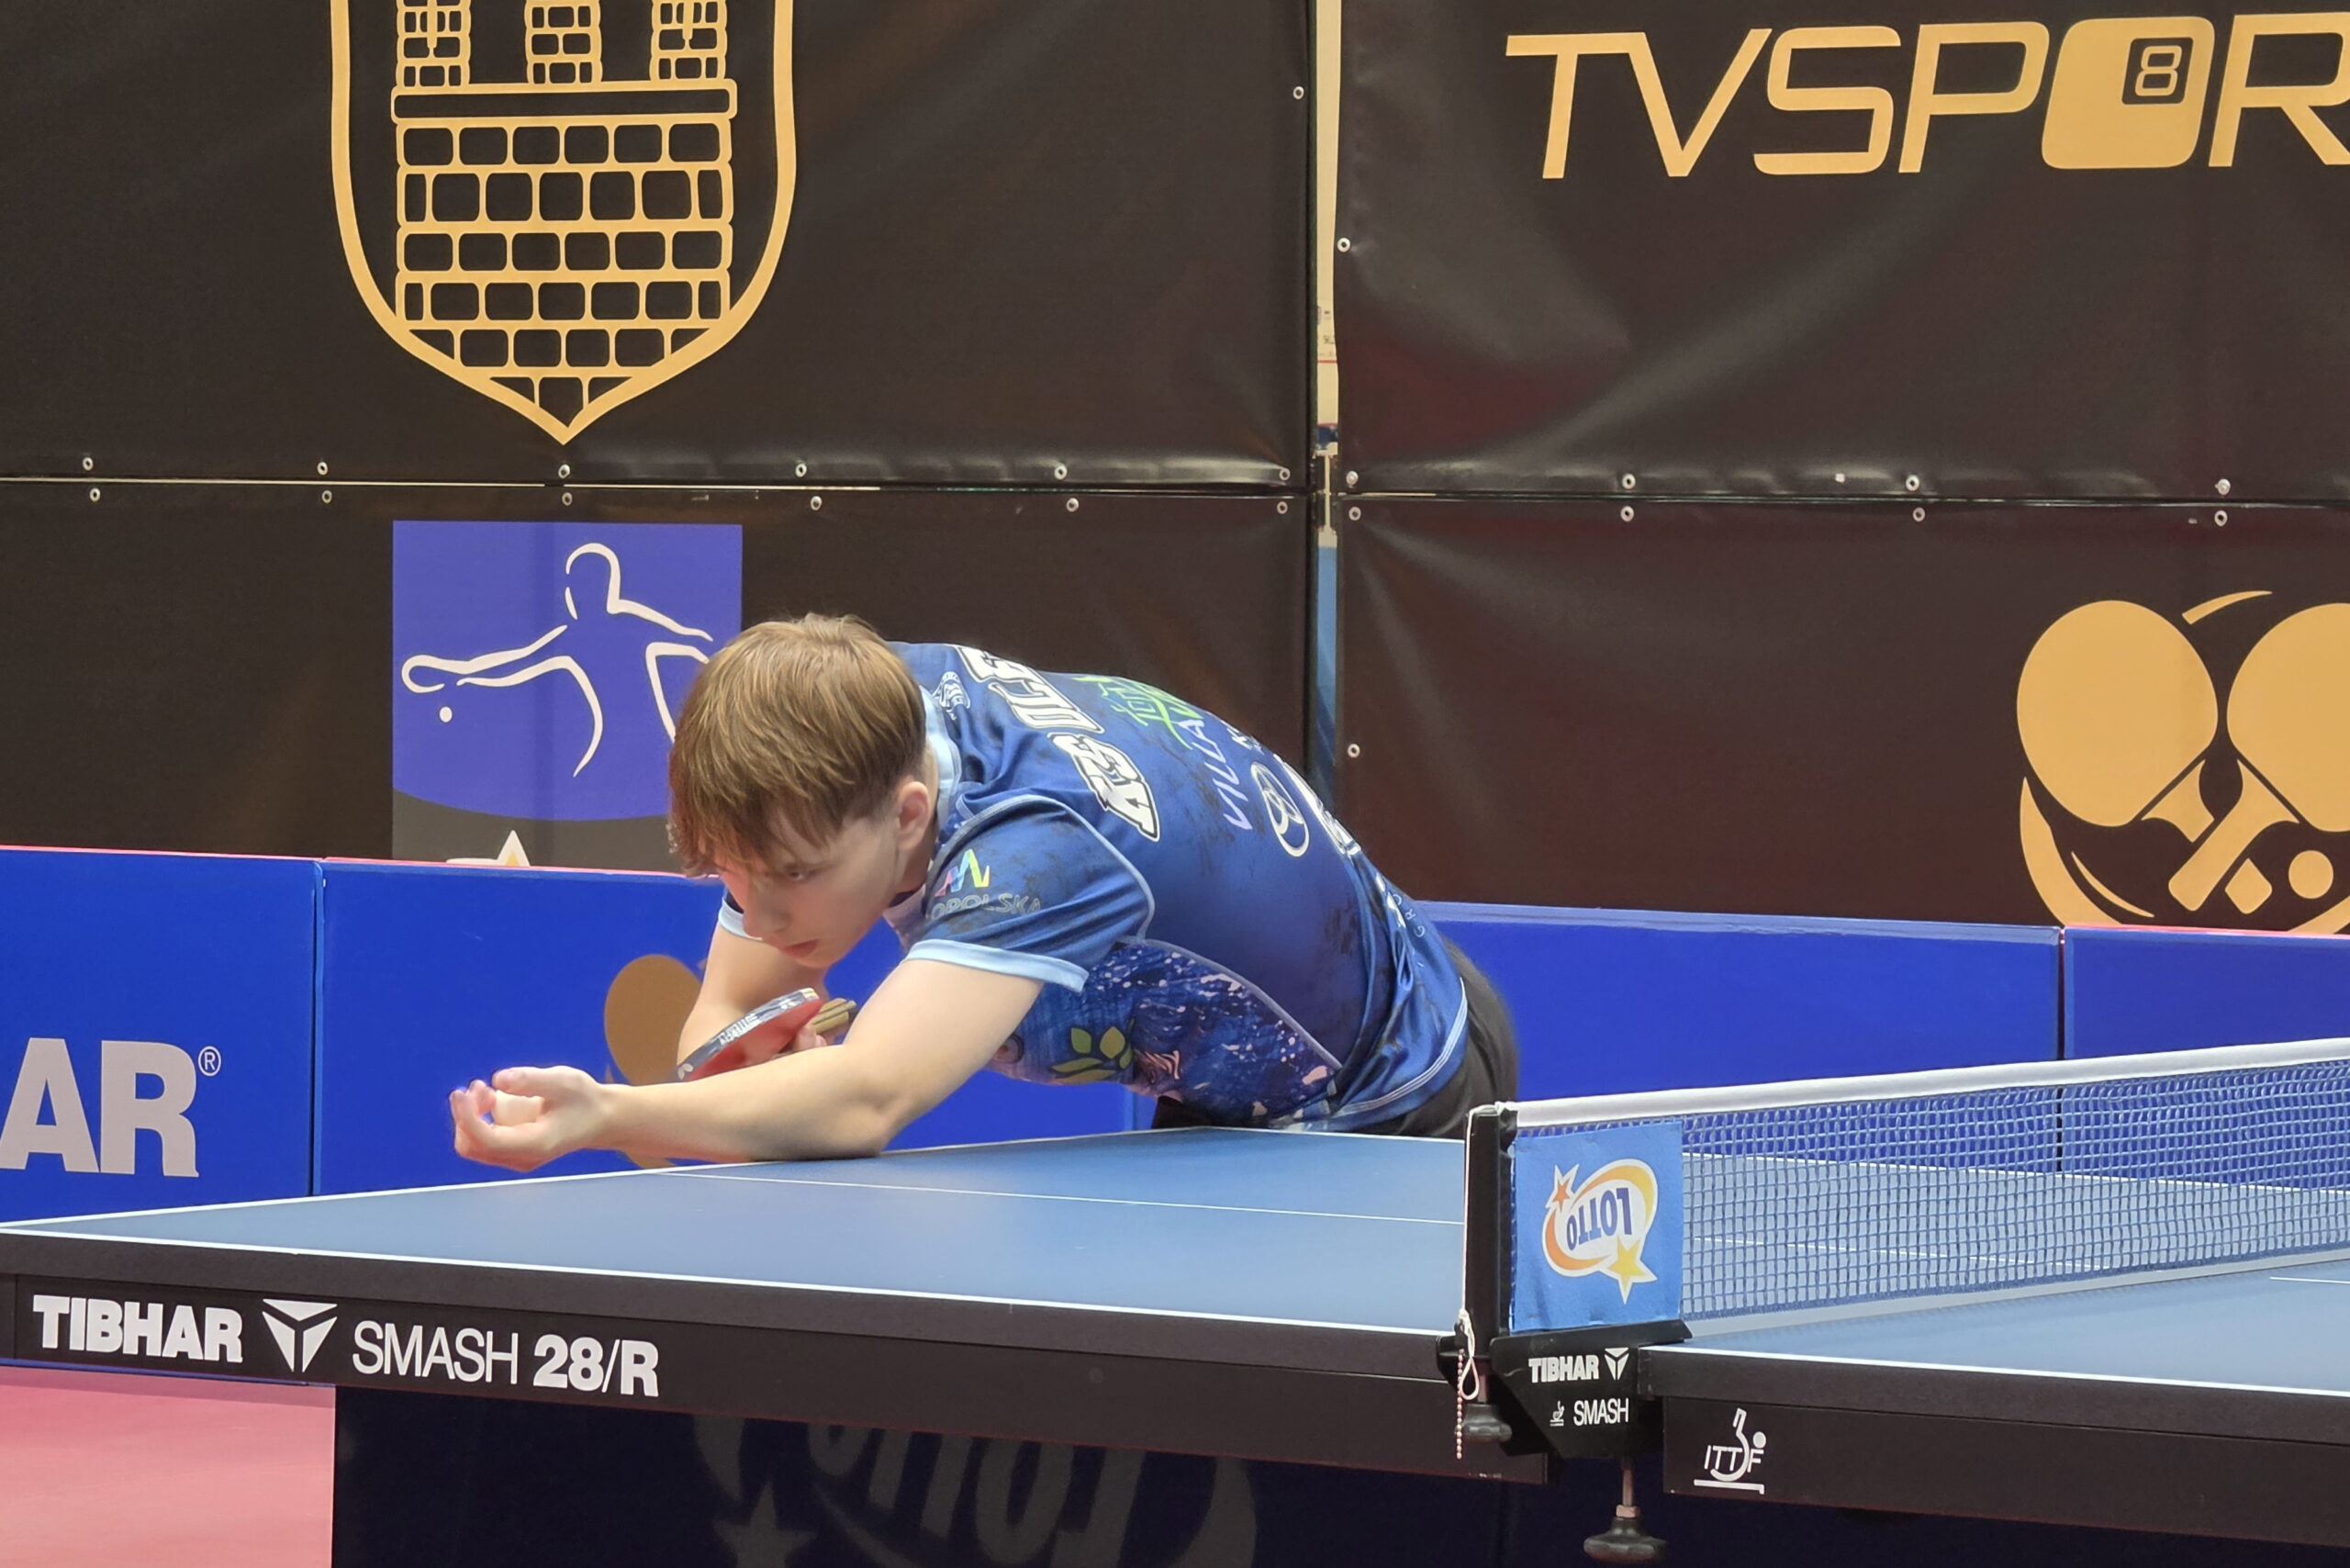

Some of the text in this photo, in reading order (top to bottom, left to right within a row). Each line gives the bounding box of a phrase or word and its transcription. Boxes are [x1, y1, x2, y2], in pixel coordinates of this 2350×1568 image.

[1179, 719, 1252, 830] VILLA
[1566, 1187, 1632, 1251] LOTTO
[32, 1294, 659, 1397] TIBHAR SMASH 28/R
[1528, 1355, 1599, 1383] TIBHAR
[1572, 1398, 1629, 1426] SMASH
[1703, 1445, 1764, 1473] ITTF
